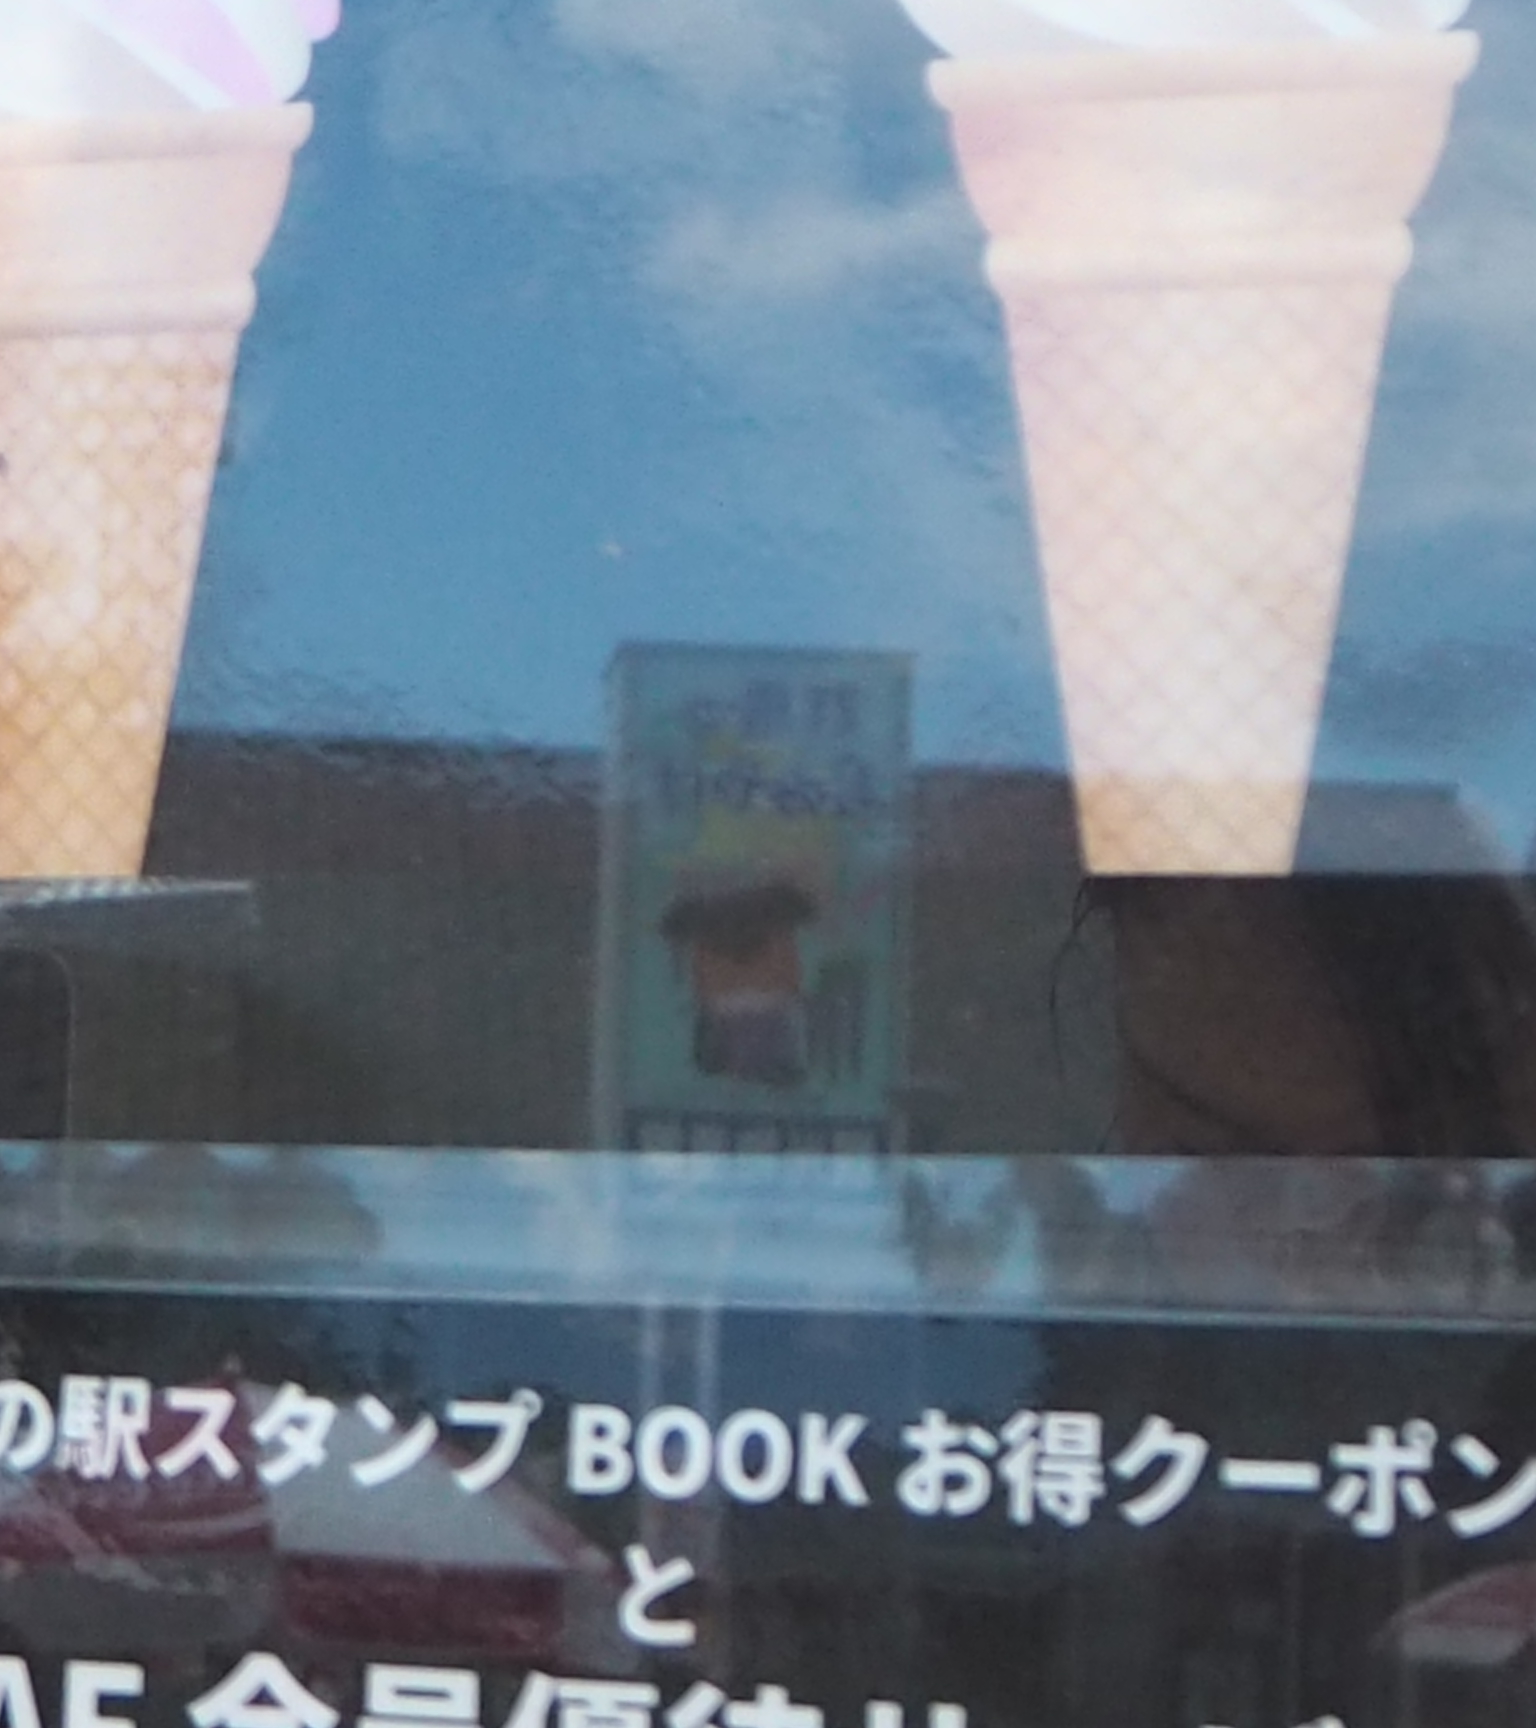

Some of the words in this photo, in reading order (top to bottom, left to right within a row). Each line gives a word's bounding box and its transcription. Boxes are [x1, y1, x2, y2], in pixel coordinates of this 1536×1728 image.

[569, 1404, 871, 1506] BOOK
[898, 1410, 1536, 1540] お得クーポン
[620, 1545, 697, 1647] と
